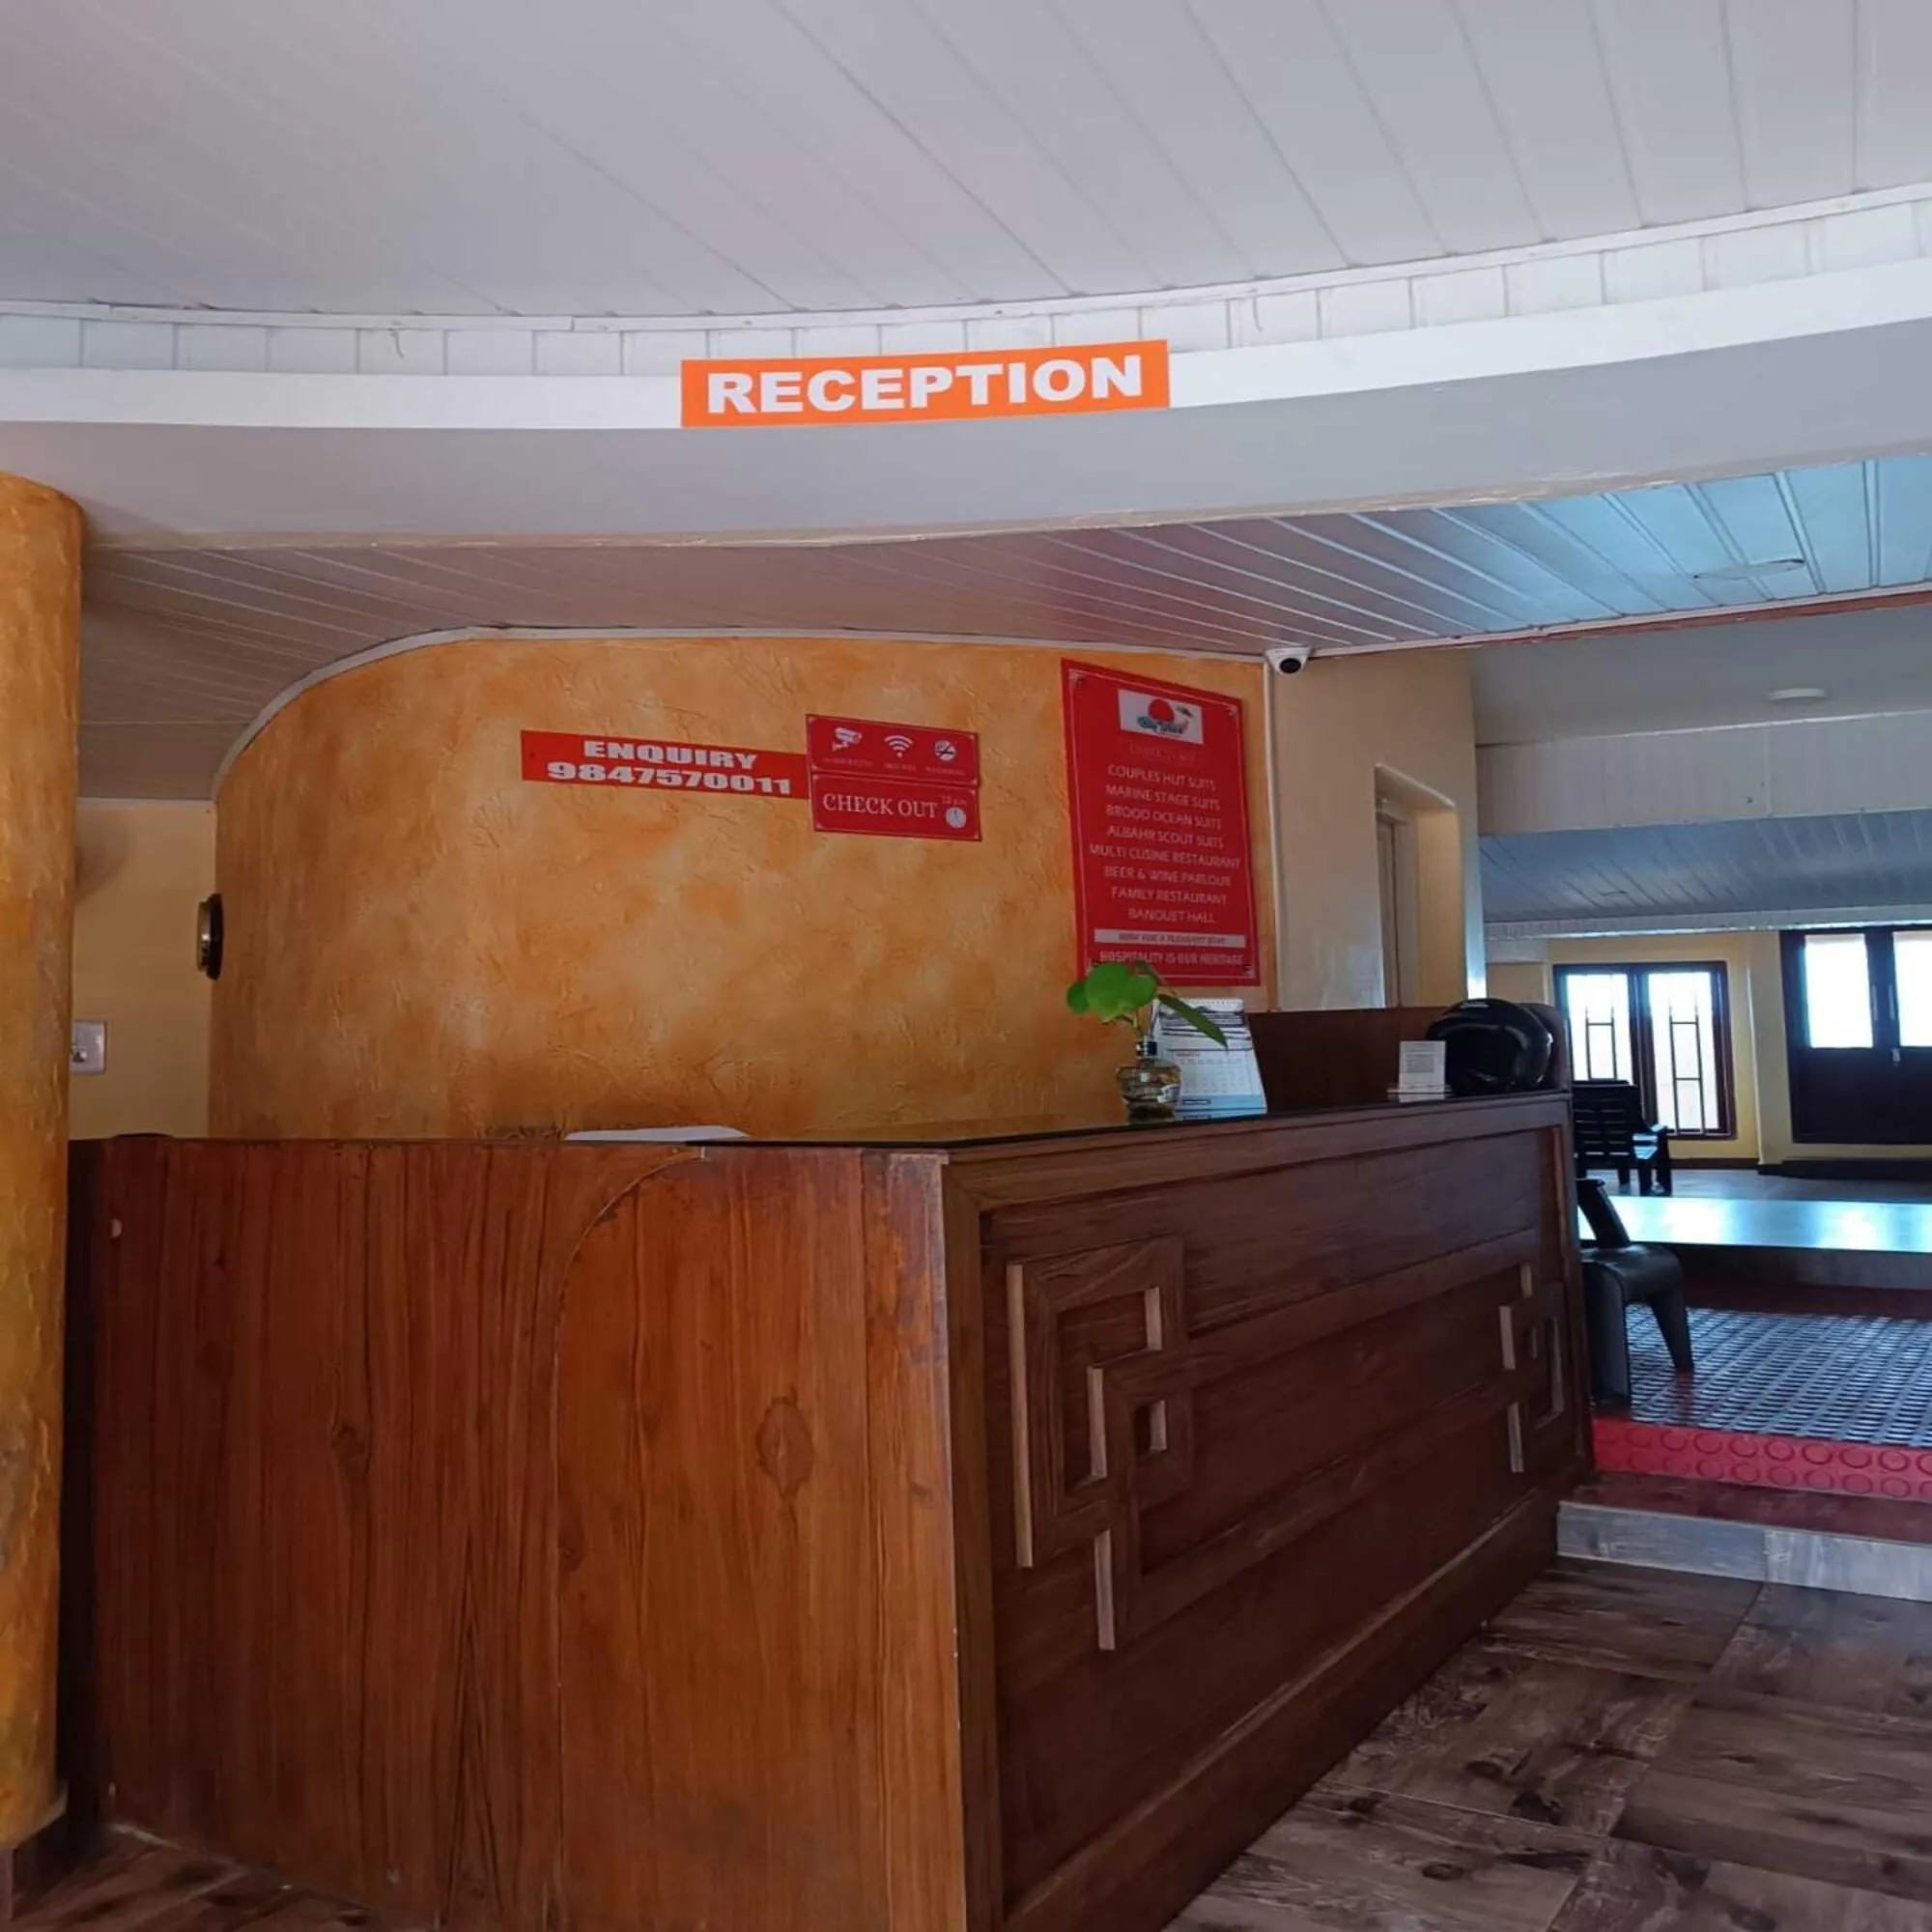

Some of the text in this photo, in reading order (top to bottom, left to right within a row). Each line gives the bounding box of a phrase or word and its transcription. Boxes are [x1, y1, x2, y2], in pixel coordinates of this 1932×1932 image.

[707, 355, 1142, 414] RECEPTION
[583, 740, 758, 769] ENQUIRY
[547, 761, 791, 794] 9847570011
[1107, 763, 1216, 791] COUPLES HUT SUITS
[822, 793, 938, 819] CHECK OUT
[1105, 783, 1221, 811] MARINE STAGE SUITS
[1152, 810, 1192, 825] OCEAN
[1194, 815, 1222, 831] SUITS
[1196, 835, 1224, 848] SUITS
[1089, 842, 1126, 857] MULTI
[1172, 852, 1241, 868] RESTAURANT
[1103, 865, 1232, 887] BEER & WINE PARLOUR
[1111, 886, 1228, 906] FAMILY RESTAURANT
[1127, 907, 1217, 923] BANQUET HALL
